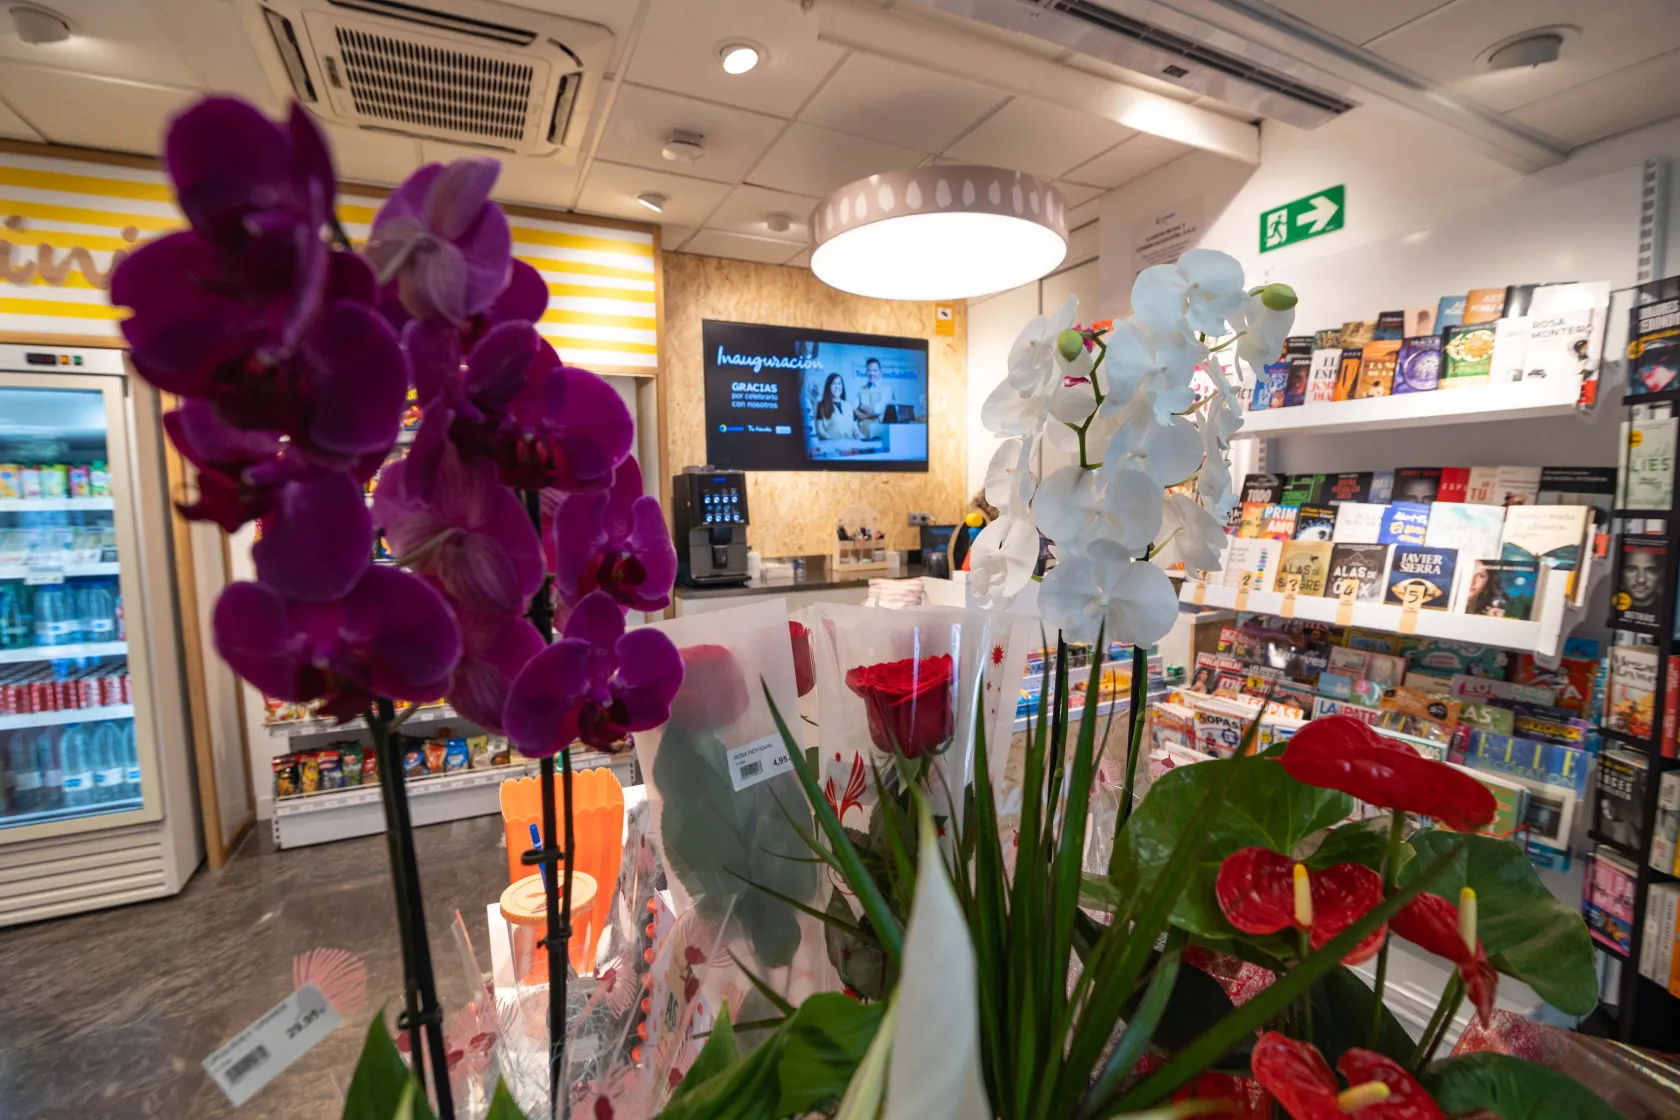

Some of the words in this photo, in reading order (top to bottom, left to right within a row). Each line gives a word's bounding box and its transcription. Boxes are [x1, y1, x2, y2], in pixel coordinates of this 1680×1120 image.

[1532, 318, 1566, 329] ROSA
[717, 345, 823, 373] Inauguración
[1315, 368, 1337, 379] ESP
[731, 382, 778, 393] GRACIAS
[1264, 505, 1298, 520] PRIM
[1267, 521, 1295, 534] AMO
[1400, 552, 1442, 565] JAVIER
[1282, 562, 1311, 576] ALAS
[1333, 565, 1367, 578] ALAS
[1399, 562, 1441, 575] SIERRA
[1242, 574, 1252, 586] 2
[1276, 576, 1321, 591] SAGRE
[1343, 583, 1354, 596] 4
[1407, 589, 1419, 603] 5
[1199, 711, 1241, 730] SOPAS
[733, 752, 748, 761] ROSA
[773, 755, 788, 766] 4,95
